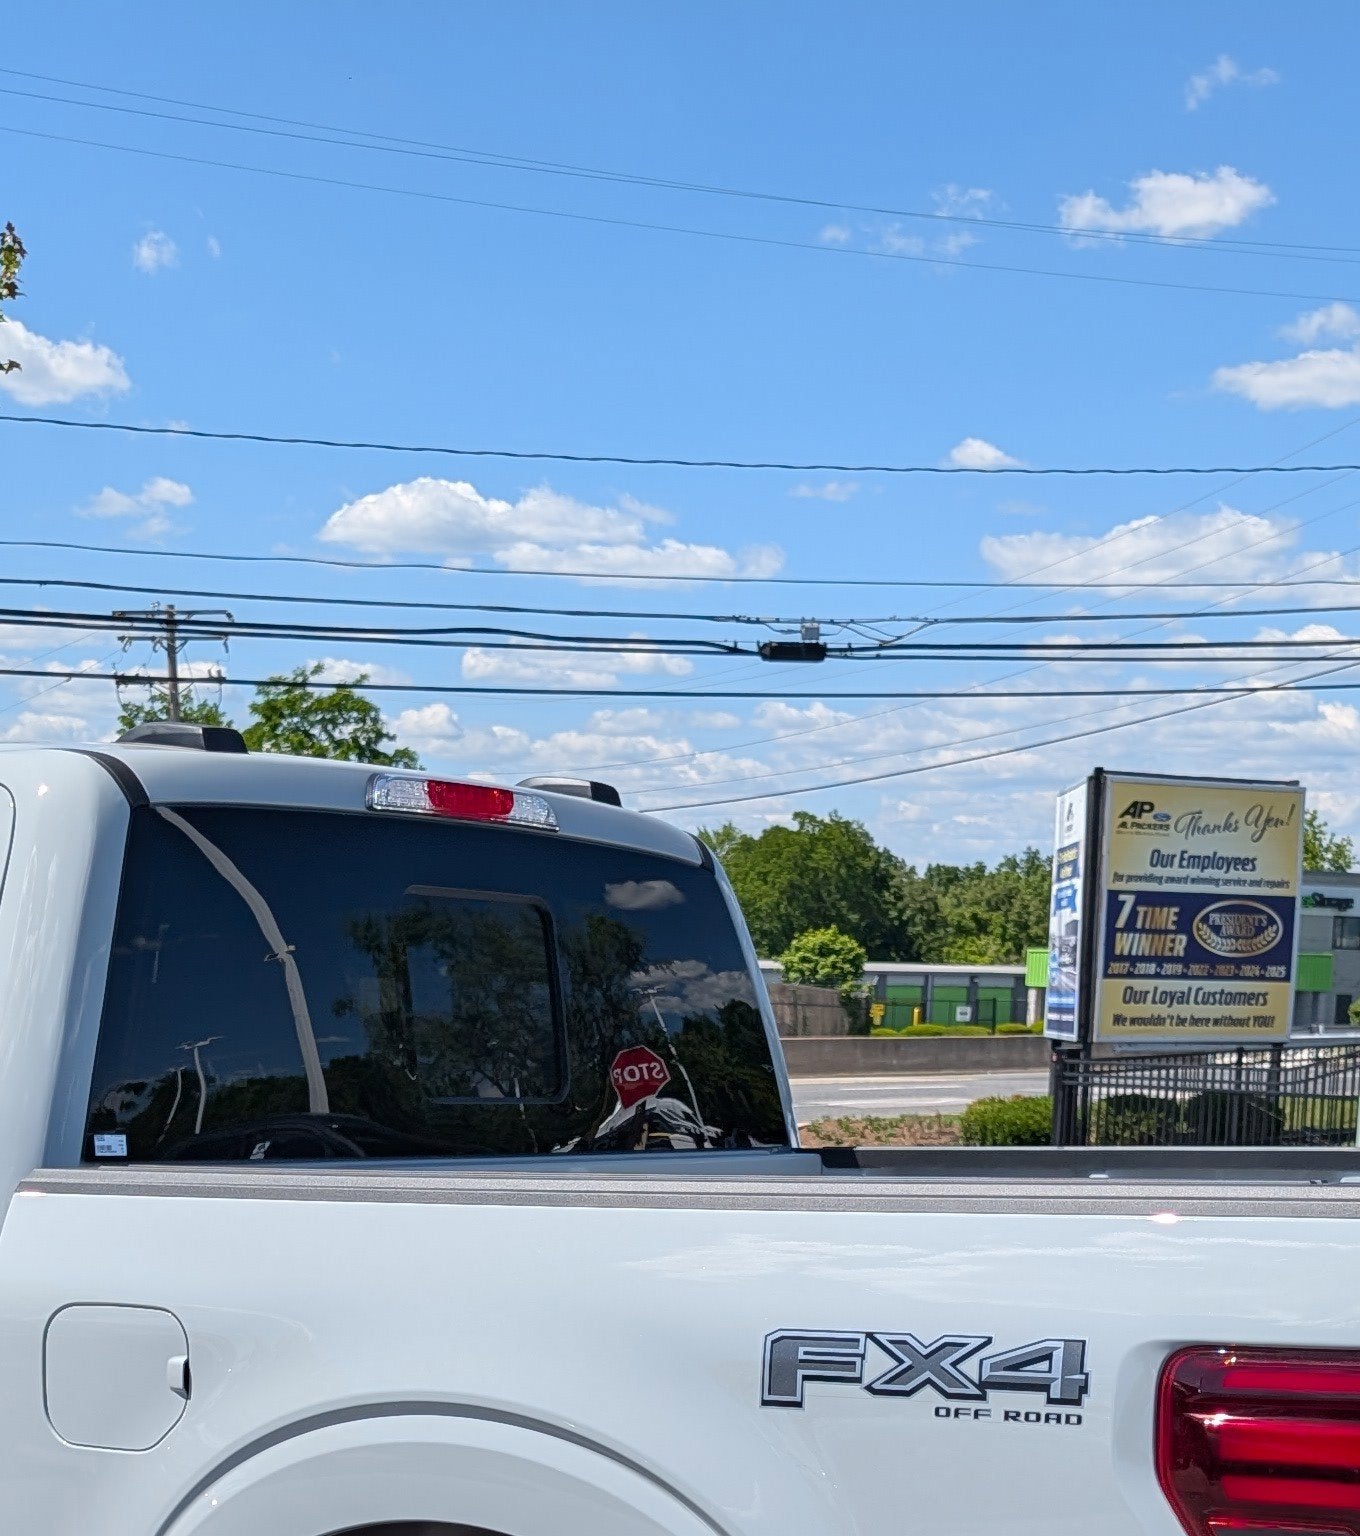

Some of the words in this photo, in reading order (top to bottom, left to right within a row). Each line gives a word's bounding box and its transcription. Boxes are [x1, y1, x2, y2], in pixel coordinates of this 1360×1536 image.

[1118, 801, 1155, 820] AP
[1174, 809, 1239, 841] Thanks
[1245, 803, 1296, 843] You!
[1149, 849, 1177, 869] Our
[1178, 850, 1258, 874] Employees
[1125, 873, 1164, 886] providing
[1165, 875, 1189, 885] award
[1221, 877, 1248, 887] service
[1248, 878, 1263, 887] and
[1115, 894, 1136, 928] 7
[1135, 906, 1180, 930] TIME
[1115, 932, 1188, 957] WINNER
[1122, 985, 1149, 1005] Our
[1152, 985, 1191, 1008] Loyal
[1193, 986, 1269, 1007] Customers
[1113, 1013, 1127, 1026] We
[1129, 1013, 1174, 1026] wouldn't
[1176, 1014, 1187, 1027] be
[1189, 1014, 1211, 1027] here
[1213, 1015, 1251, 1027] without
[760, 1329, 1090, 1407] FX4
[934, 1406, 993, 1420] OFF
[1003, 1410, 1083, 1426] ROAD
